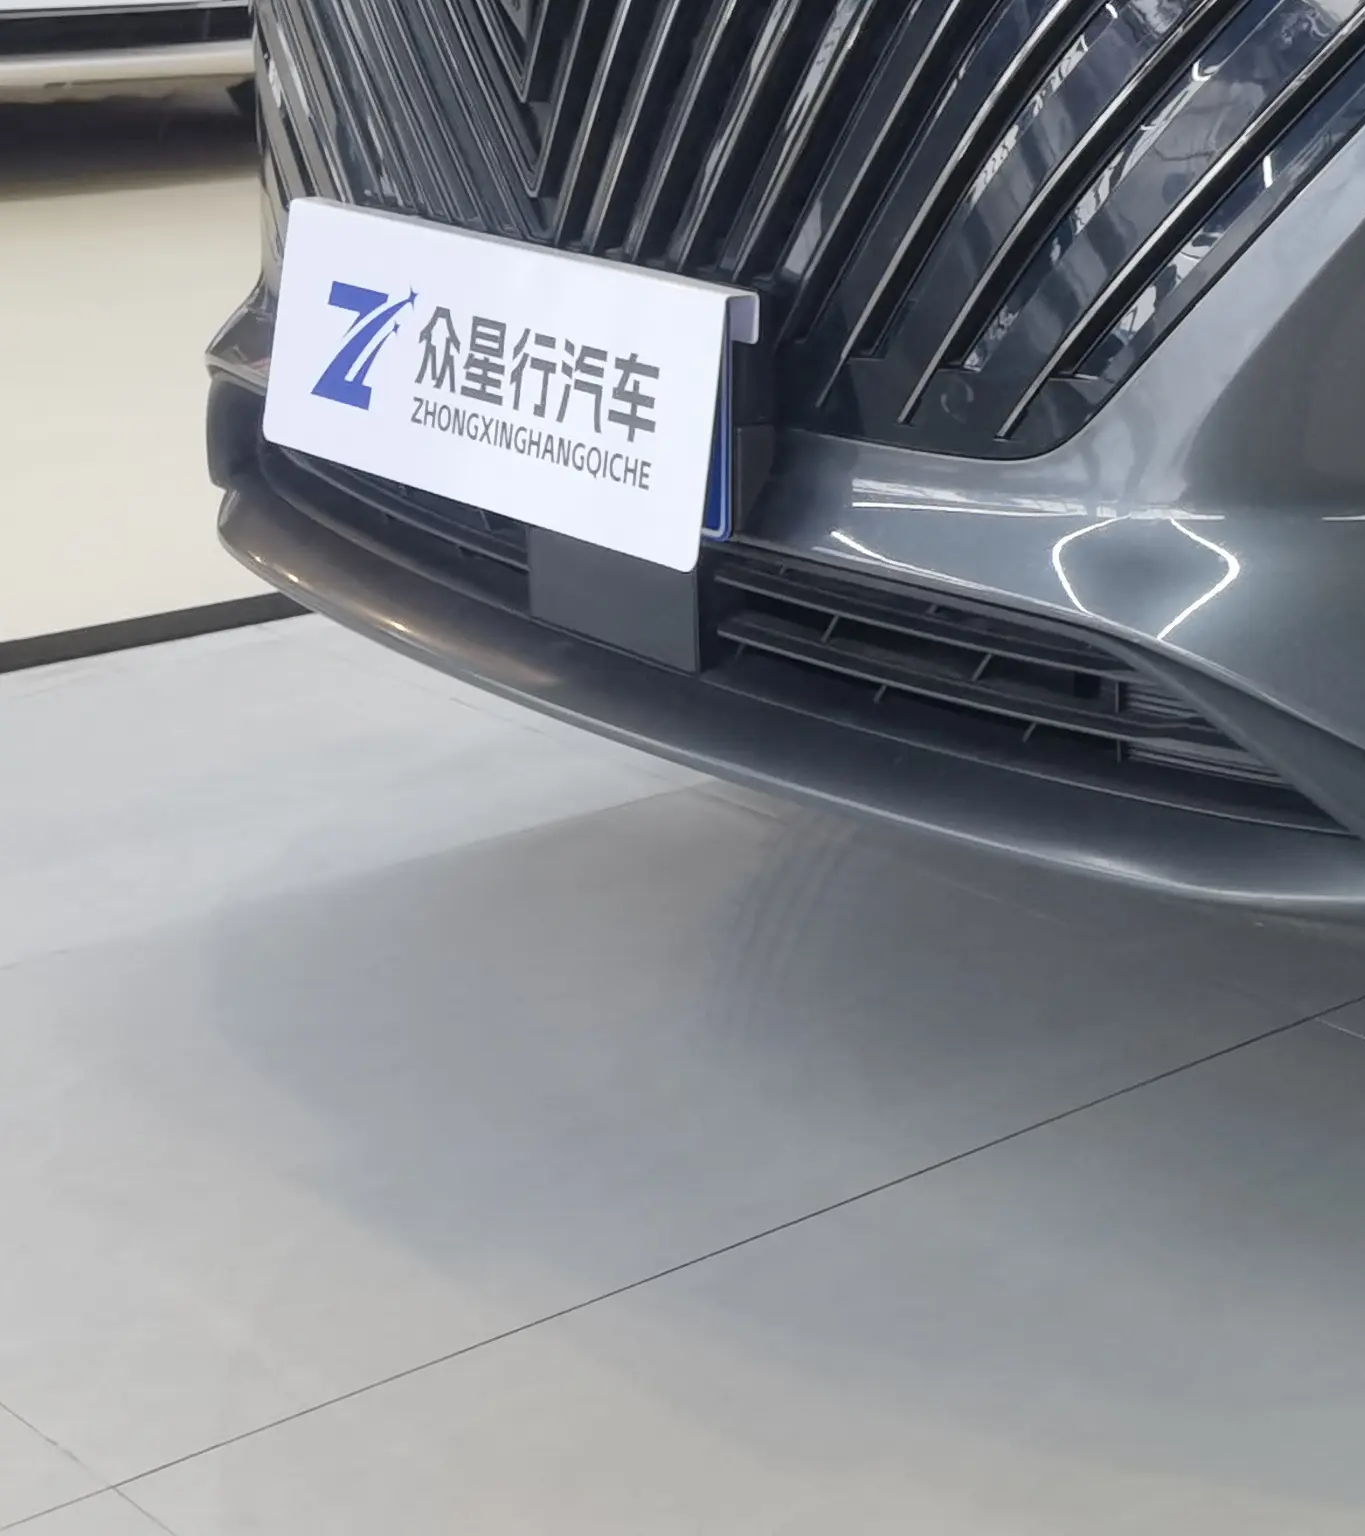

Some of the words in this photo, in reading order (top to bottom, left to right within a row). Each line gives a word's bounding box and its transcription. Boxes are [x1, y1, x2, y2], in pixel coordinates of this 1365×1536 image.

[414, 305, 661, 443] 众星行汽车
[410, 396, 653, 491] ZHONGXINGHANGQICHE
